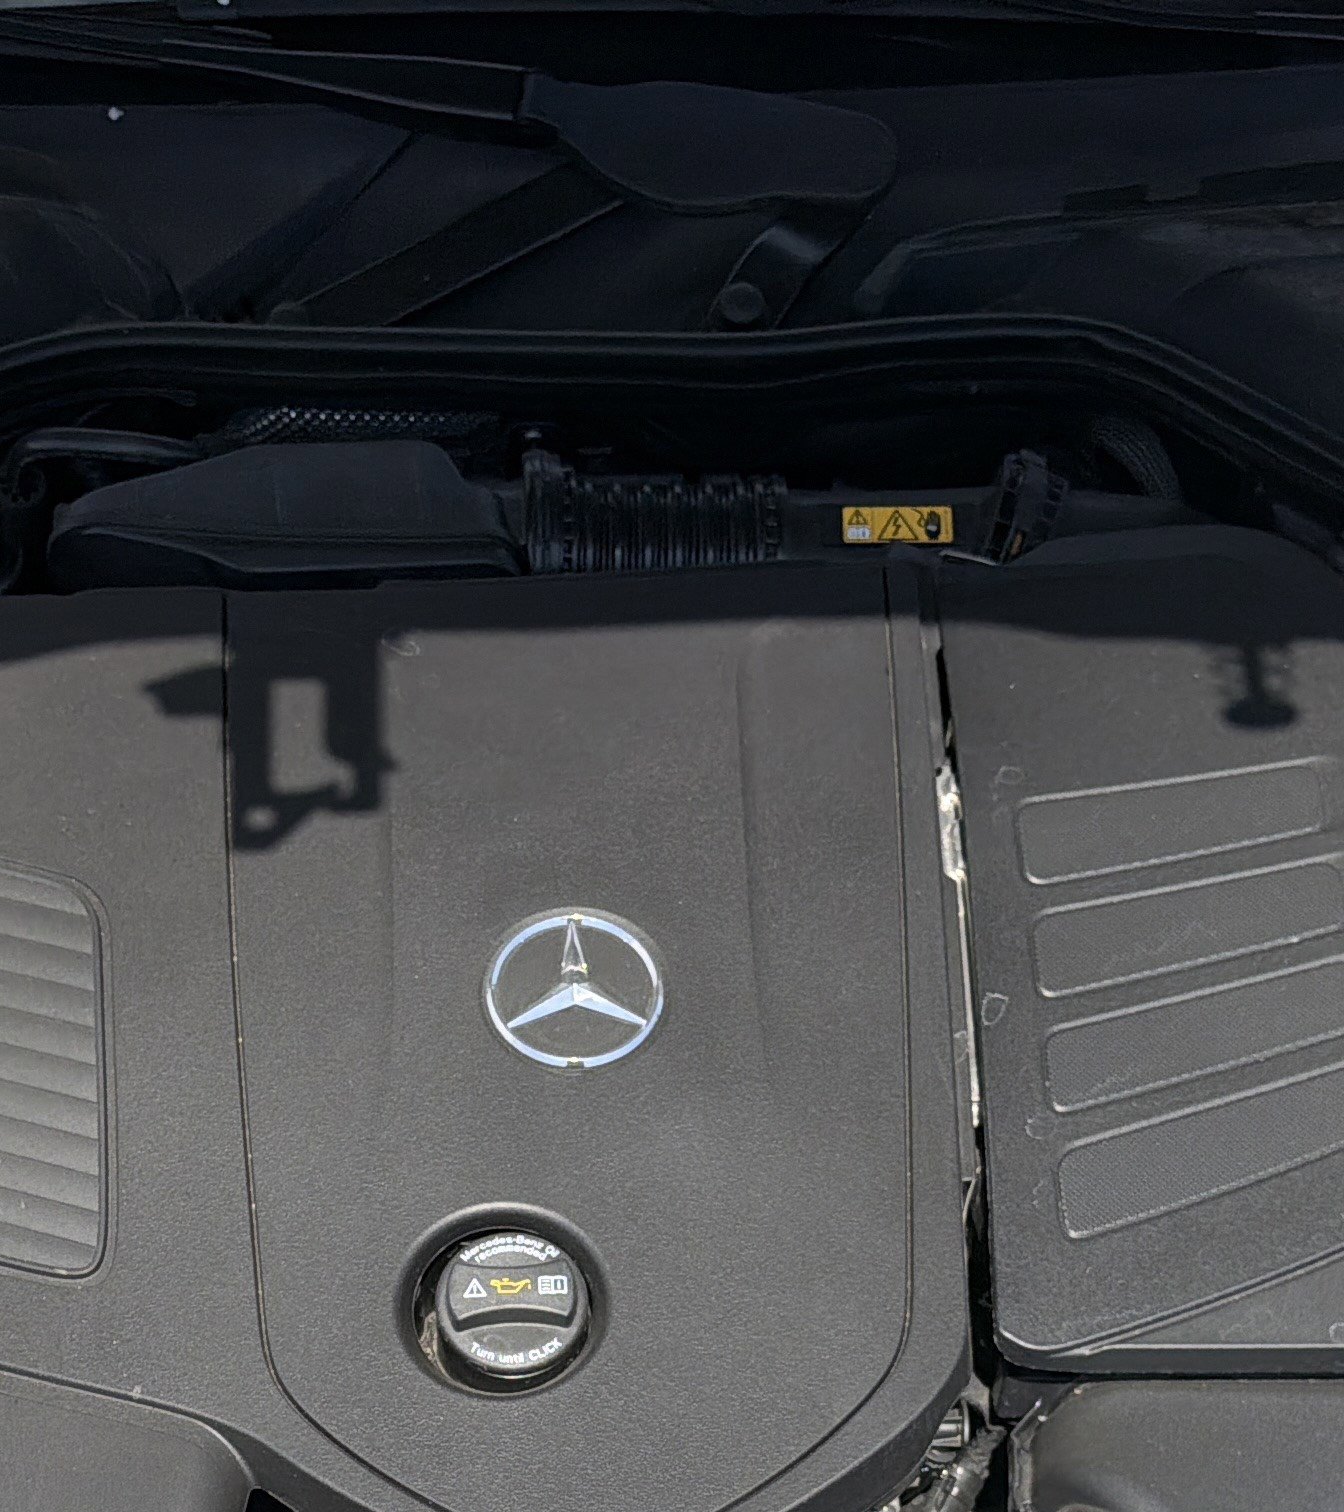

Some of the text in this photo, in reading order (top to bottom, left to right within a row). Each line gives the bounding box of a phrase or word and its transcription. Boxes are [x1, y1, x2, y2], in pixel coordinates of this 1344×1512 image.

[460, 1235, 560, 1262] Mercedes-Benz Oil
[475, 1244, 547, 1264] recommended
[471, 1337, 562, 1363] Turn until CLICK
